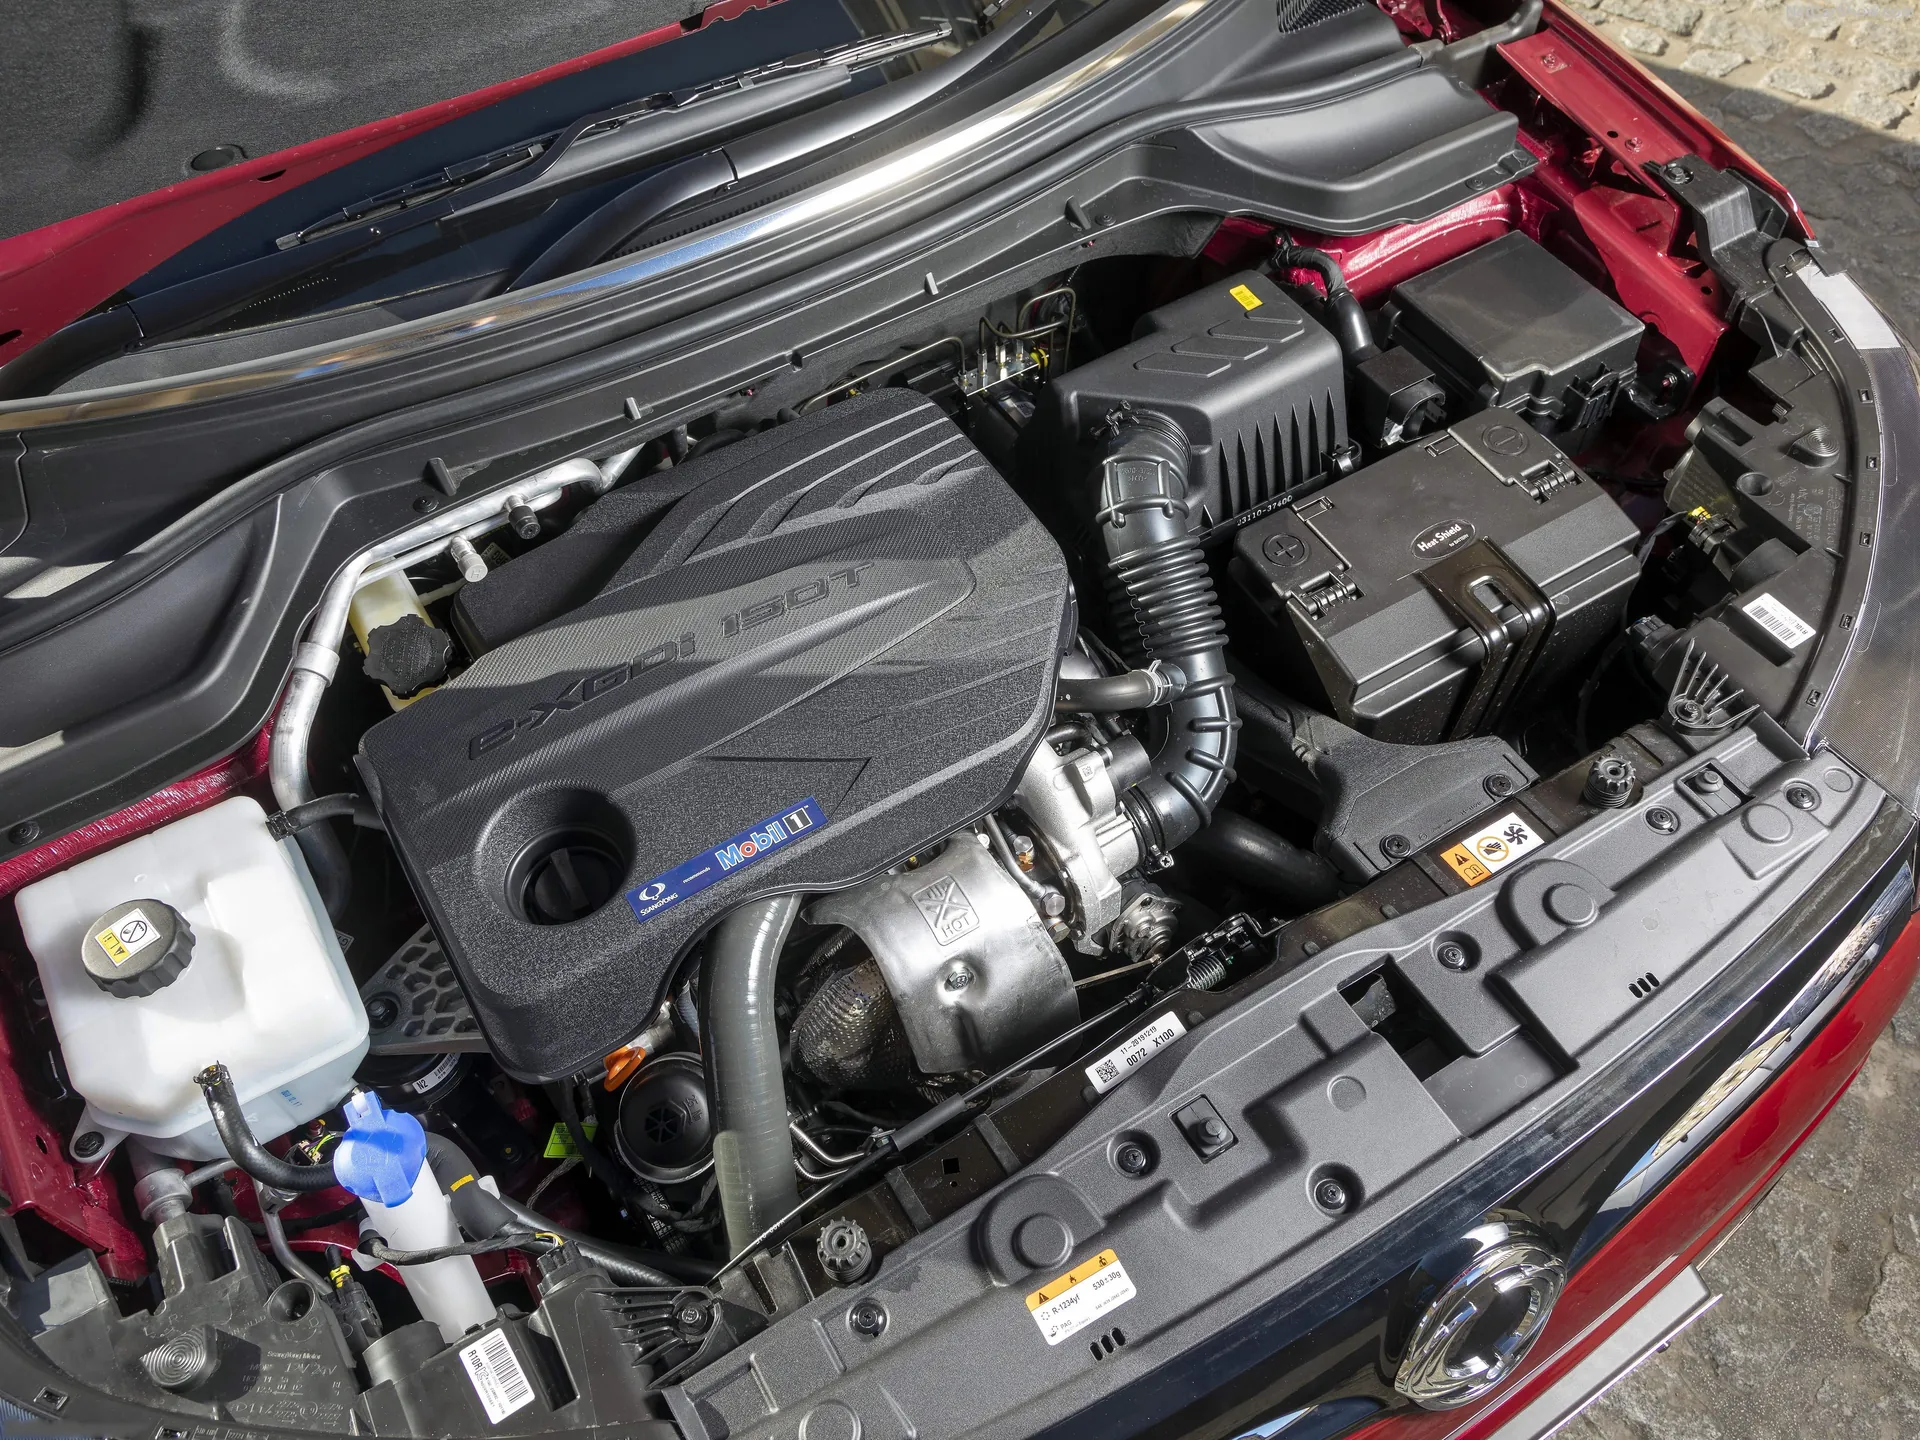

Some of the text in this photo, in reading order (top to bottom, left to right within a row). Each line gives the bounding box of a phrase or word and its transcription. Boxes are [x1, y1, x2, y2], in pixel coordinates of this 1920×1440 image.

[1417, 523, 1462, 552] Heat Shield
[469, 631, 696, 761] e-XGDi
[719, 561, 876, 638] 150T
[714, 820, 788, 871] Mobil
[941, 911, 970, 938] HOT
[1120, 1025, 1158, 1055] 11-20191219
[1126, 1028, 1175, 1067] 0072 X100
[416, 1079, 429, 1090] N2
[1051, 1293, 1081, 1315] R-1234yf
[1060, 1320, 1073, 1330] PAG
[467, 1349, 483, 1371] R10R
